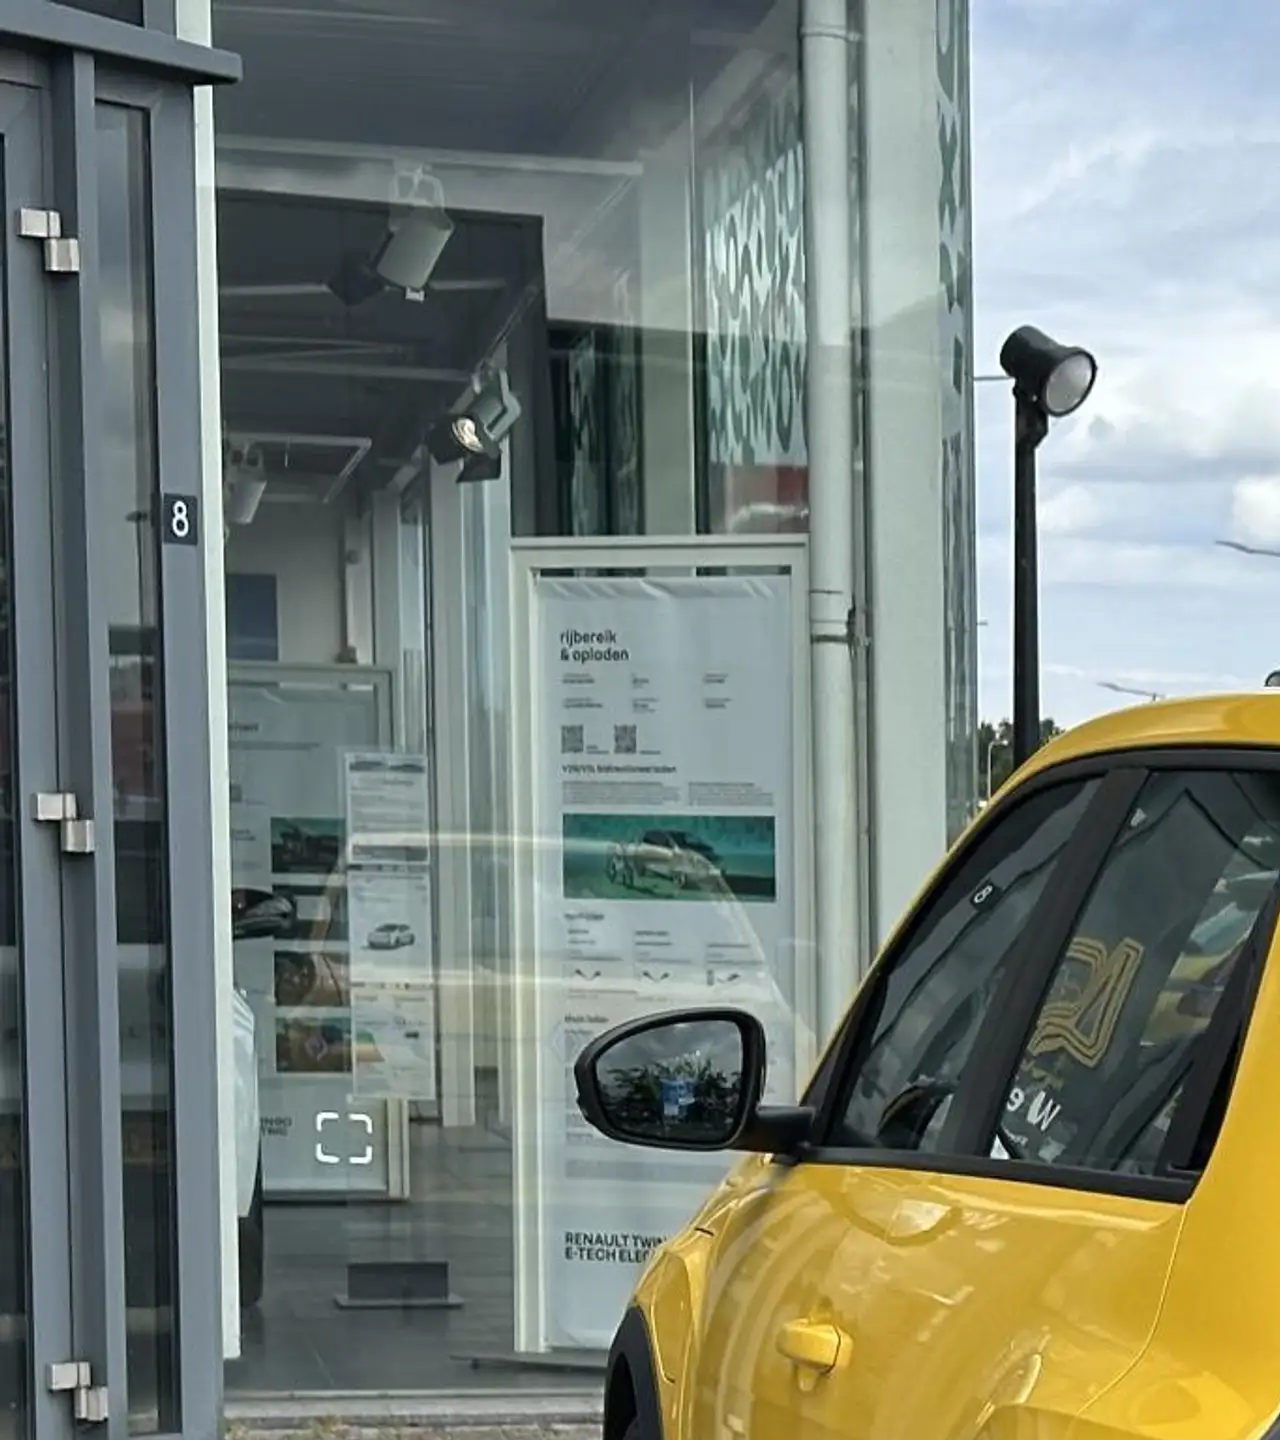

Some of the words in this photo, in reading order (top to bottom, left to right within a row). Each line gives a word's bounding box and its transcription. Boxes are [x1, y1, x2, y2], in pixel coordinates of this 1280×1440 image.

[172, 500, 189, 537] 8
[560, 629, 617, 647] rijbereik
[565, 1231, 629, 1248] RENAULT
